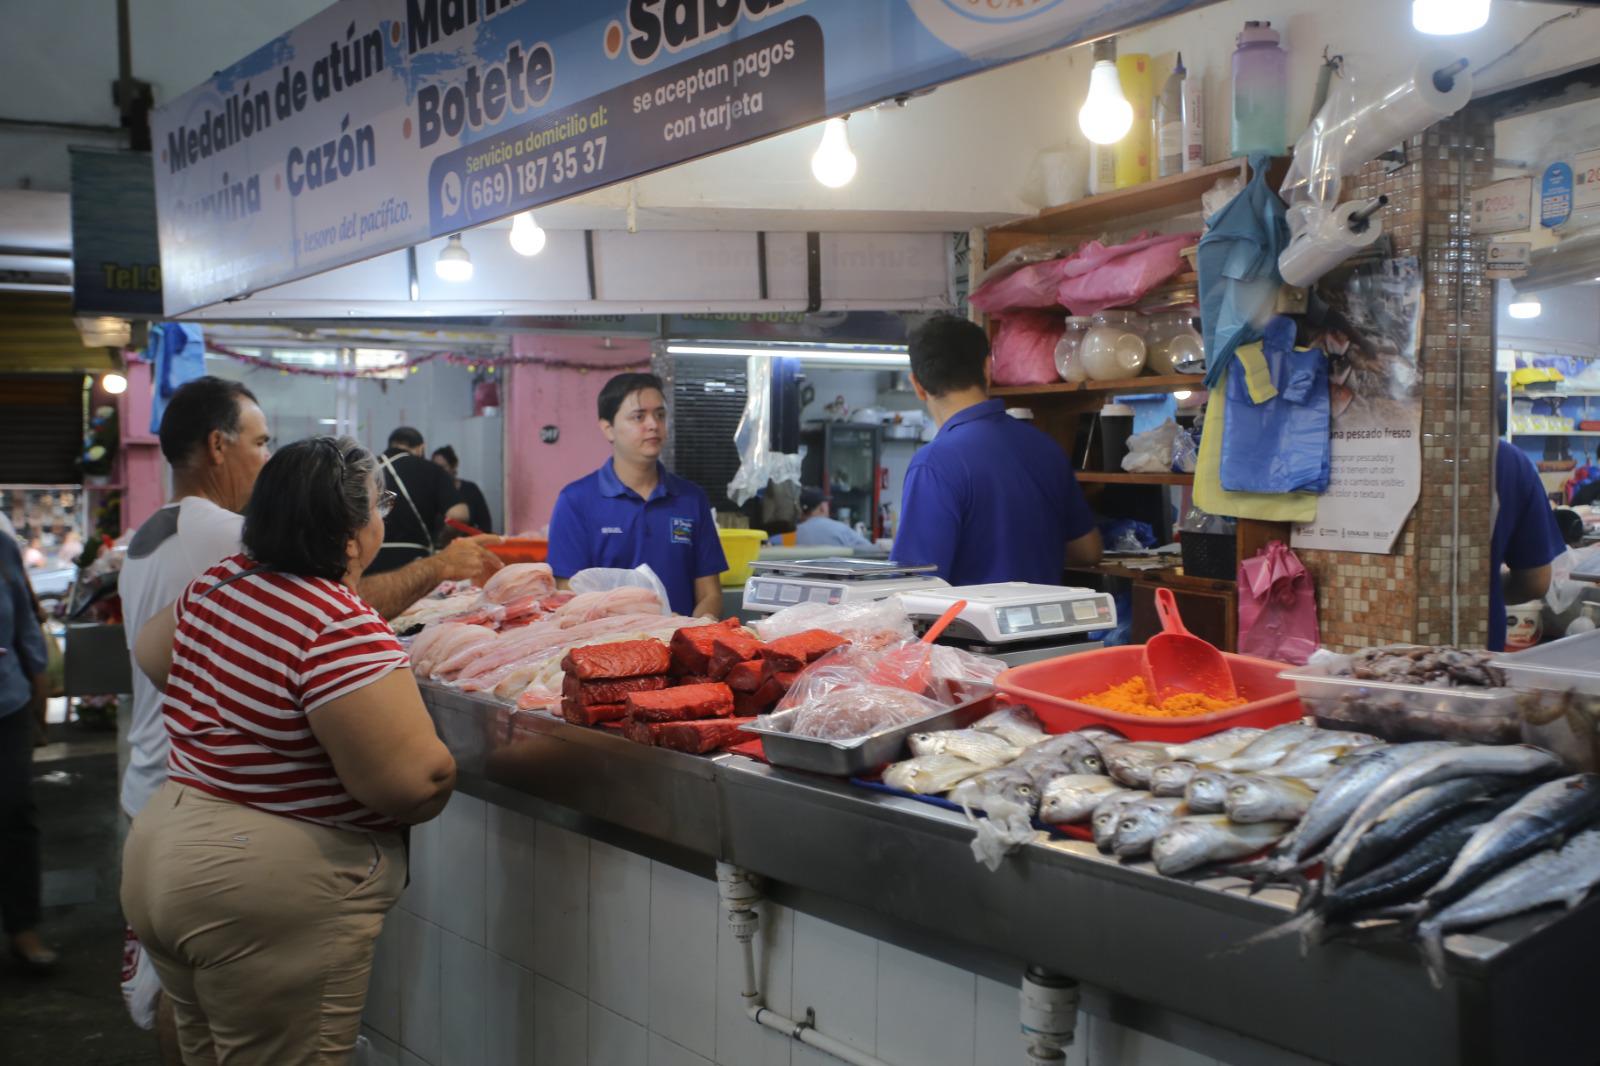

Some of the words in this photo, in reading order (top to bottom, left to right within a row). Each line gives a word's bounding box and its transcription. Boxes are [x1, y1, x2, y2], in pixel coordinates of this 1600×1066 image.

[168, 82, 271, 174] Medallón
[275, 66, 308, 121] de
[312, 21, 384, 102] atún
[417, 45, 552, 149] Botete
[633, 95, 652, 114] se
[655, 63, 729, 104] aceptan
[733, 39, 795, 87] pagos
[466, 144, 513, 174] Servicio
[515, 146, 523, 156] a
[525, 113, 587, 152] domicilio
[590, 105, 608, 129] al:
[664, 114, 696, 141] con
[699, 91, 763, 130] tarjeta
[286, 114, 375, 197] Cazón
[464, 163, 513, 220] (669)
[517, 156, 548, 195] 187
[552, 146, 578, 184] 35
[583, 136, 608, 174] 37
[304, 225, 337, 253] tesoro
[339, 211, 356, 241] del
[360, 197, 412, 242] pacífico.
[1346, 428, 1383, 441] pescado
[1385, 427, 1412, 439] fresco
